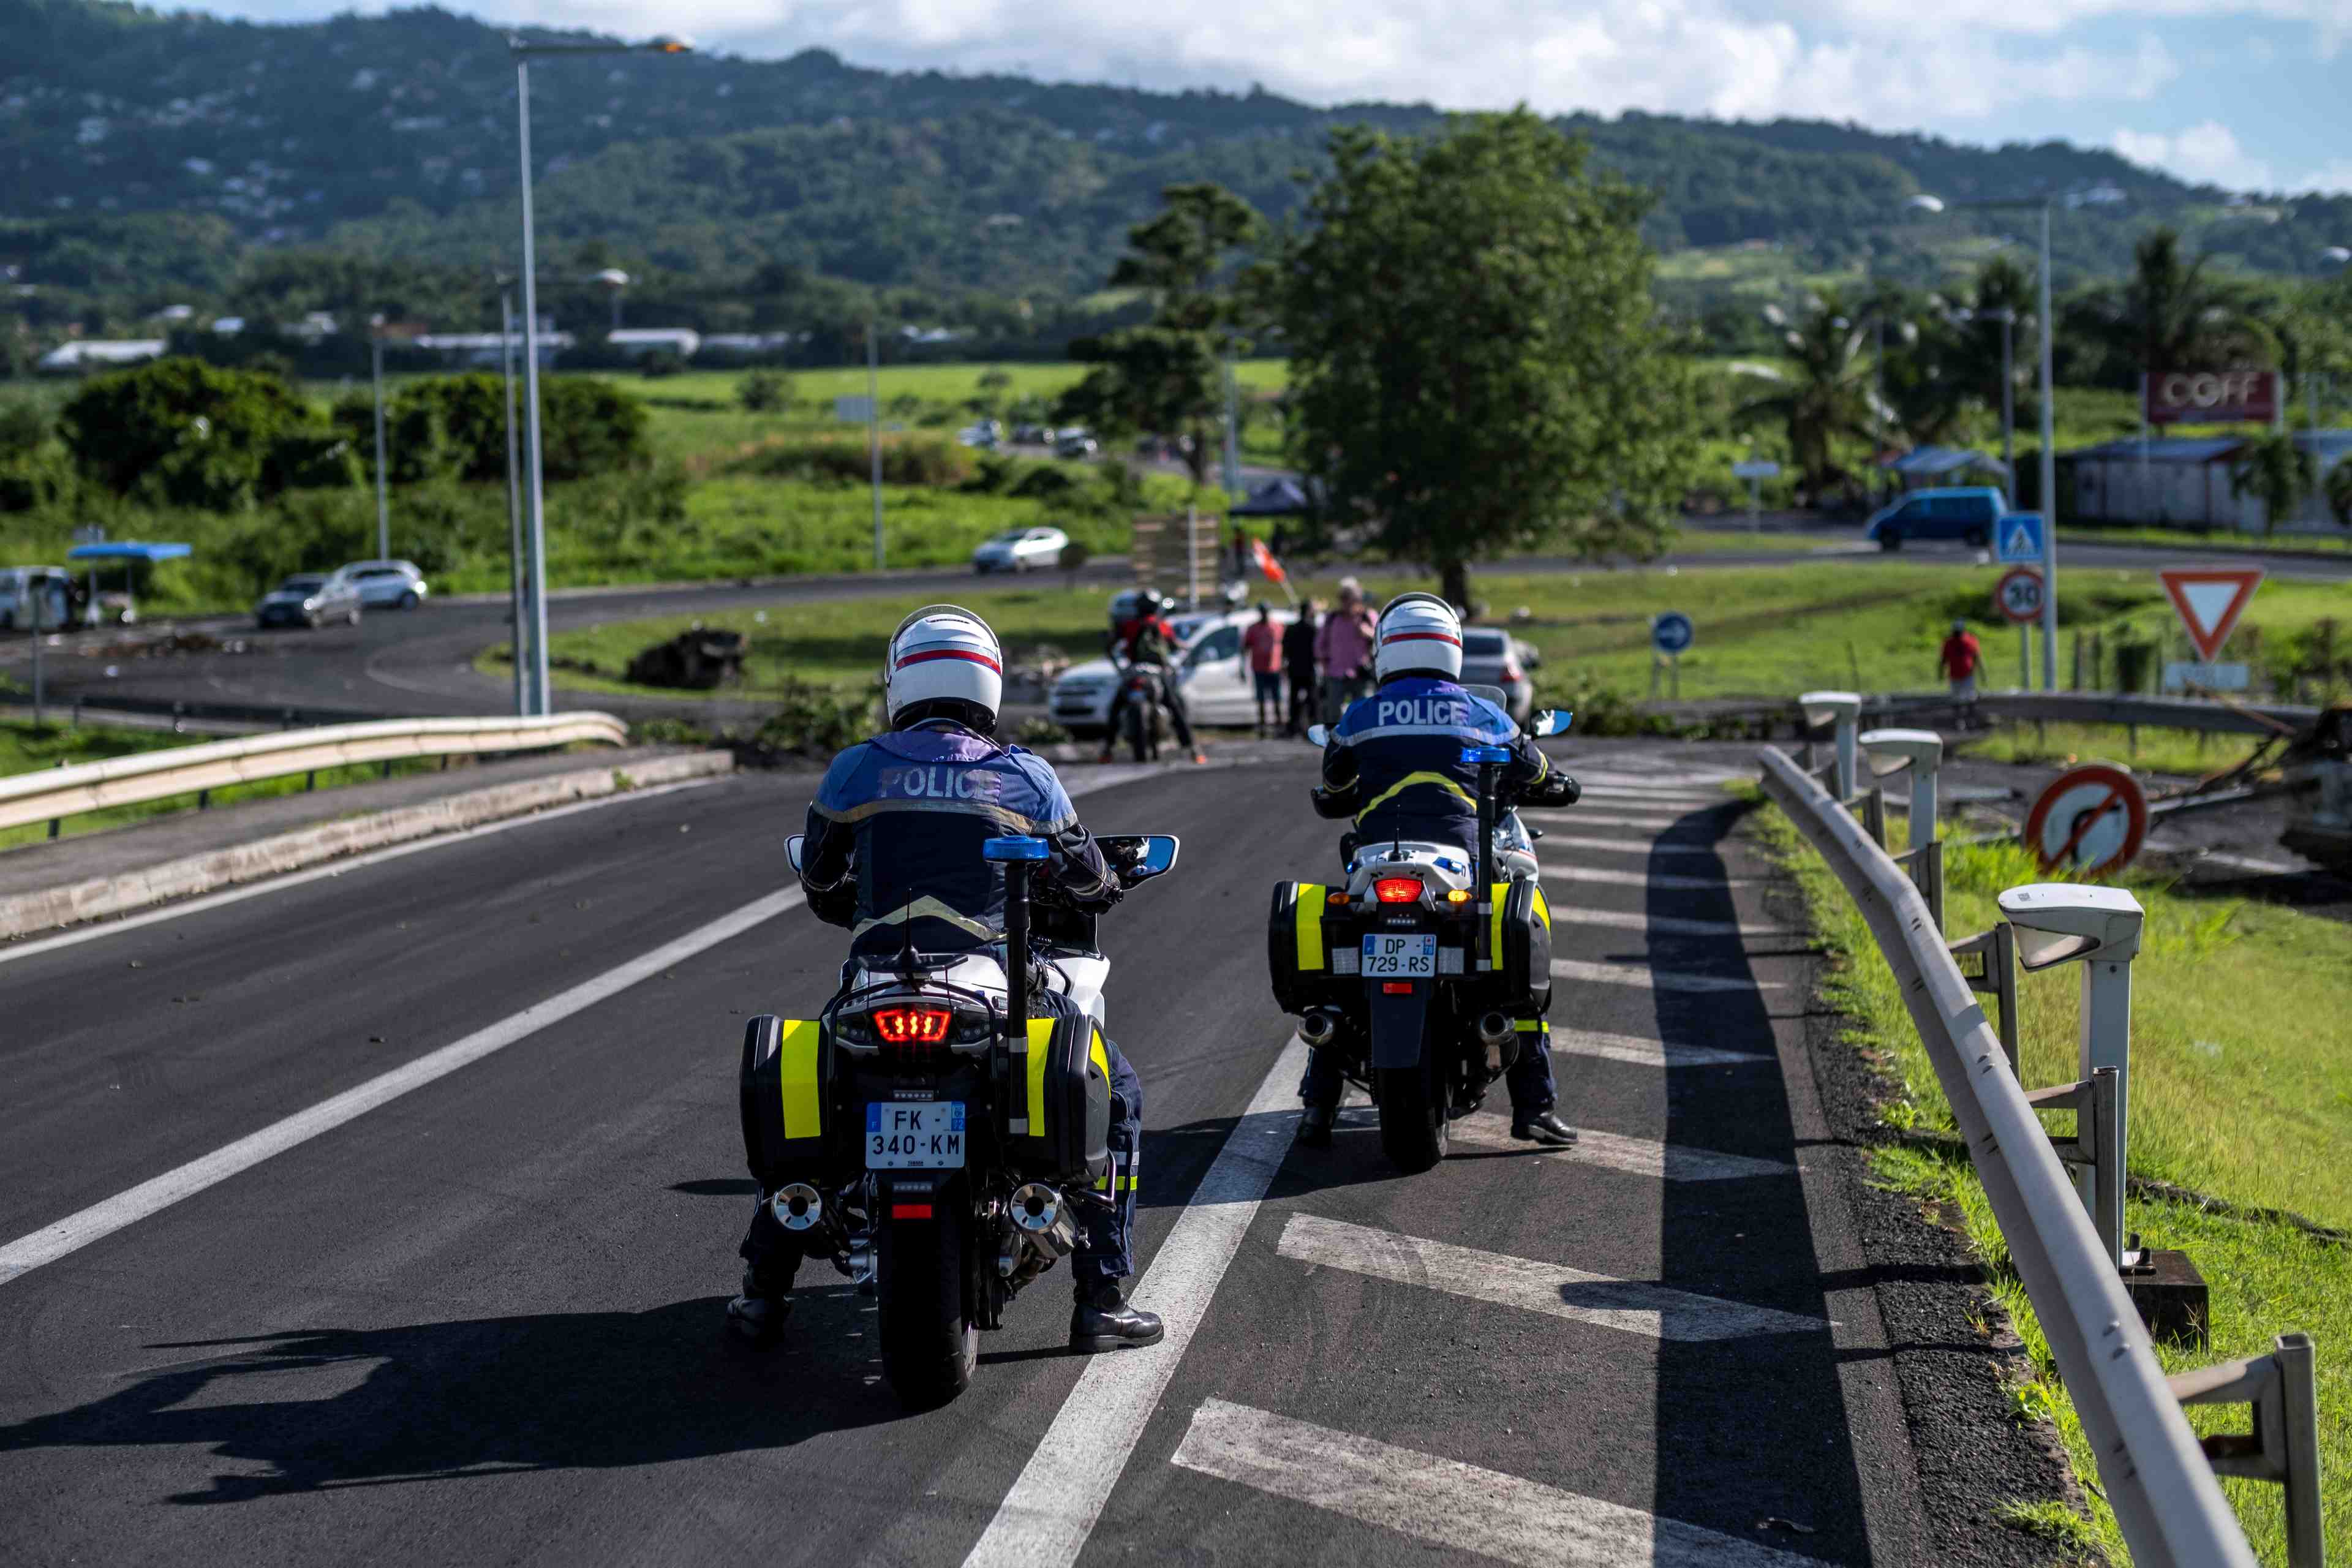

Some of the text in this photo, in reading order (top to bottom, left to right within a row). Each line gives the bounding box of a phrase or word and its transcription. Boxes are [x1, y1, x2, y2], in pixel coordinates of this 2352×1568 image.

[1379, 699, 1469, 726] POLICE
[1385, 939, 1406, 954] DP
[1367, 957, 1429, 972] 729-RS
[895, 1110, 922, 1130] FK
[873, 1134, 960, 1155] 340-KM
